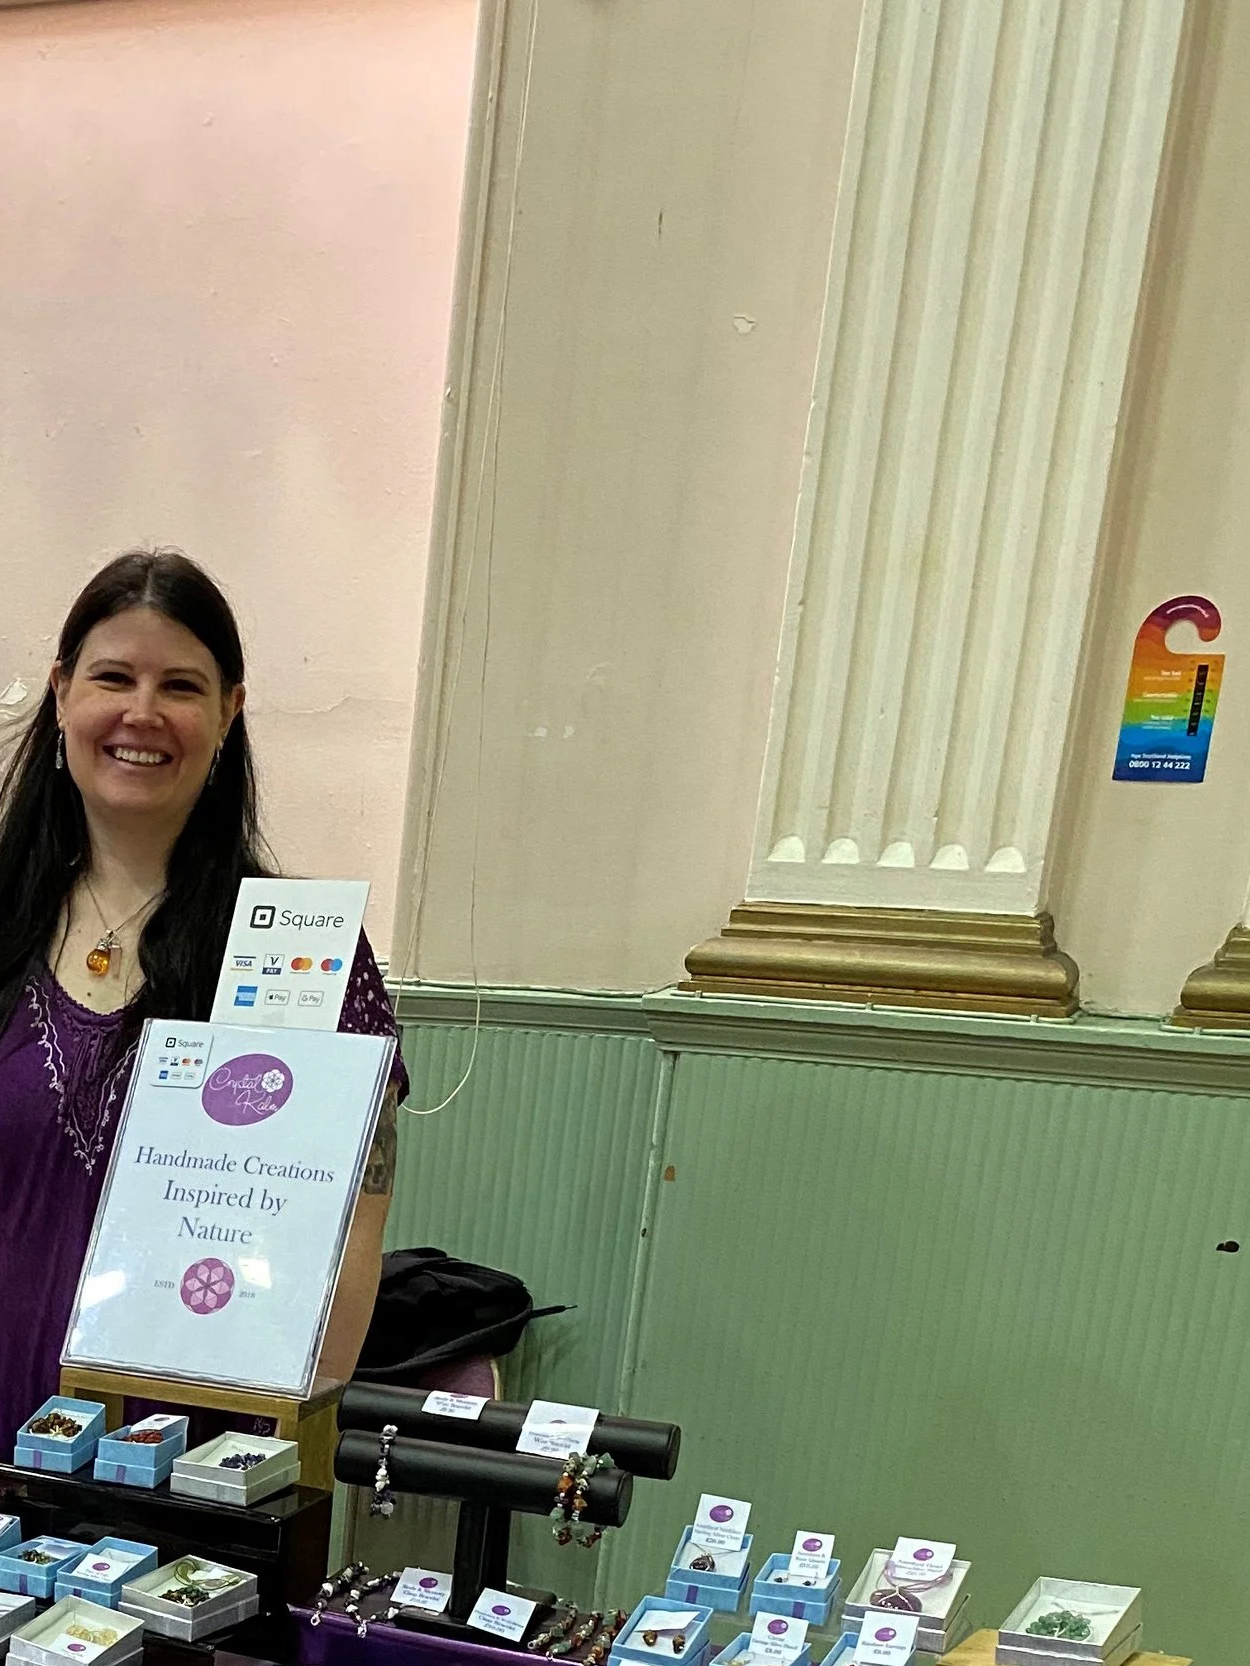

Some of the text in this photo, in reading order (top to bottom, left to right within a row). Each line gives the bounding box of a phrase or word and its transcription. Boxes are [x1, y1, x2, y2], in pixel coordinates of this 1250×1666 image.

[1129, 760, 1190, 770] 0800 12 44 222
[279, 909, 344, 931] Square
[270, 956, 279, 965] V
[274, 993, 286, 1002] Pay
[309, 995, 320, 1003] Pay
[178, 1039, 204, 1048] Square
[209, 1067, 266, 1094] Crystal
[235, 1090, 279, 1116] Kalm
[134, 1145, 335, 1183] Handmade Creations
[163, 1179, 288, 1216] Inspired by
[177, 1216, 253, 1245] Nature
